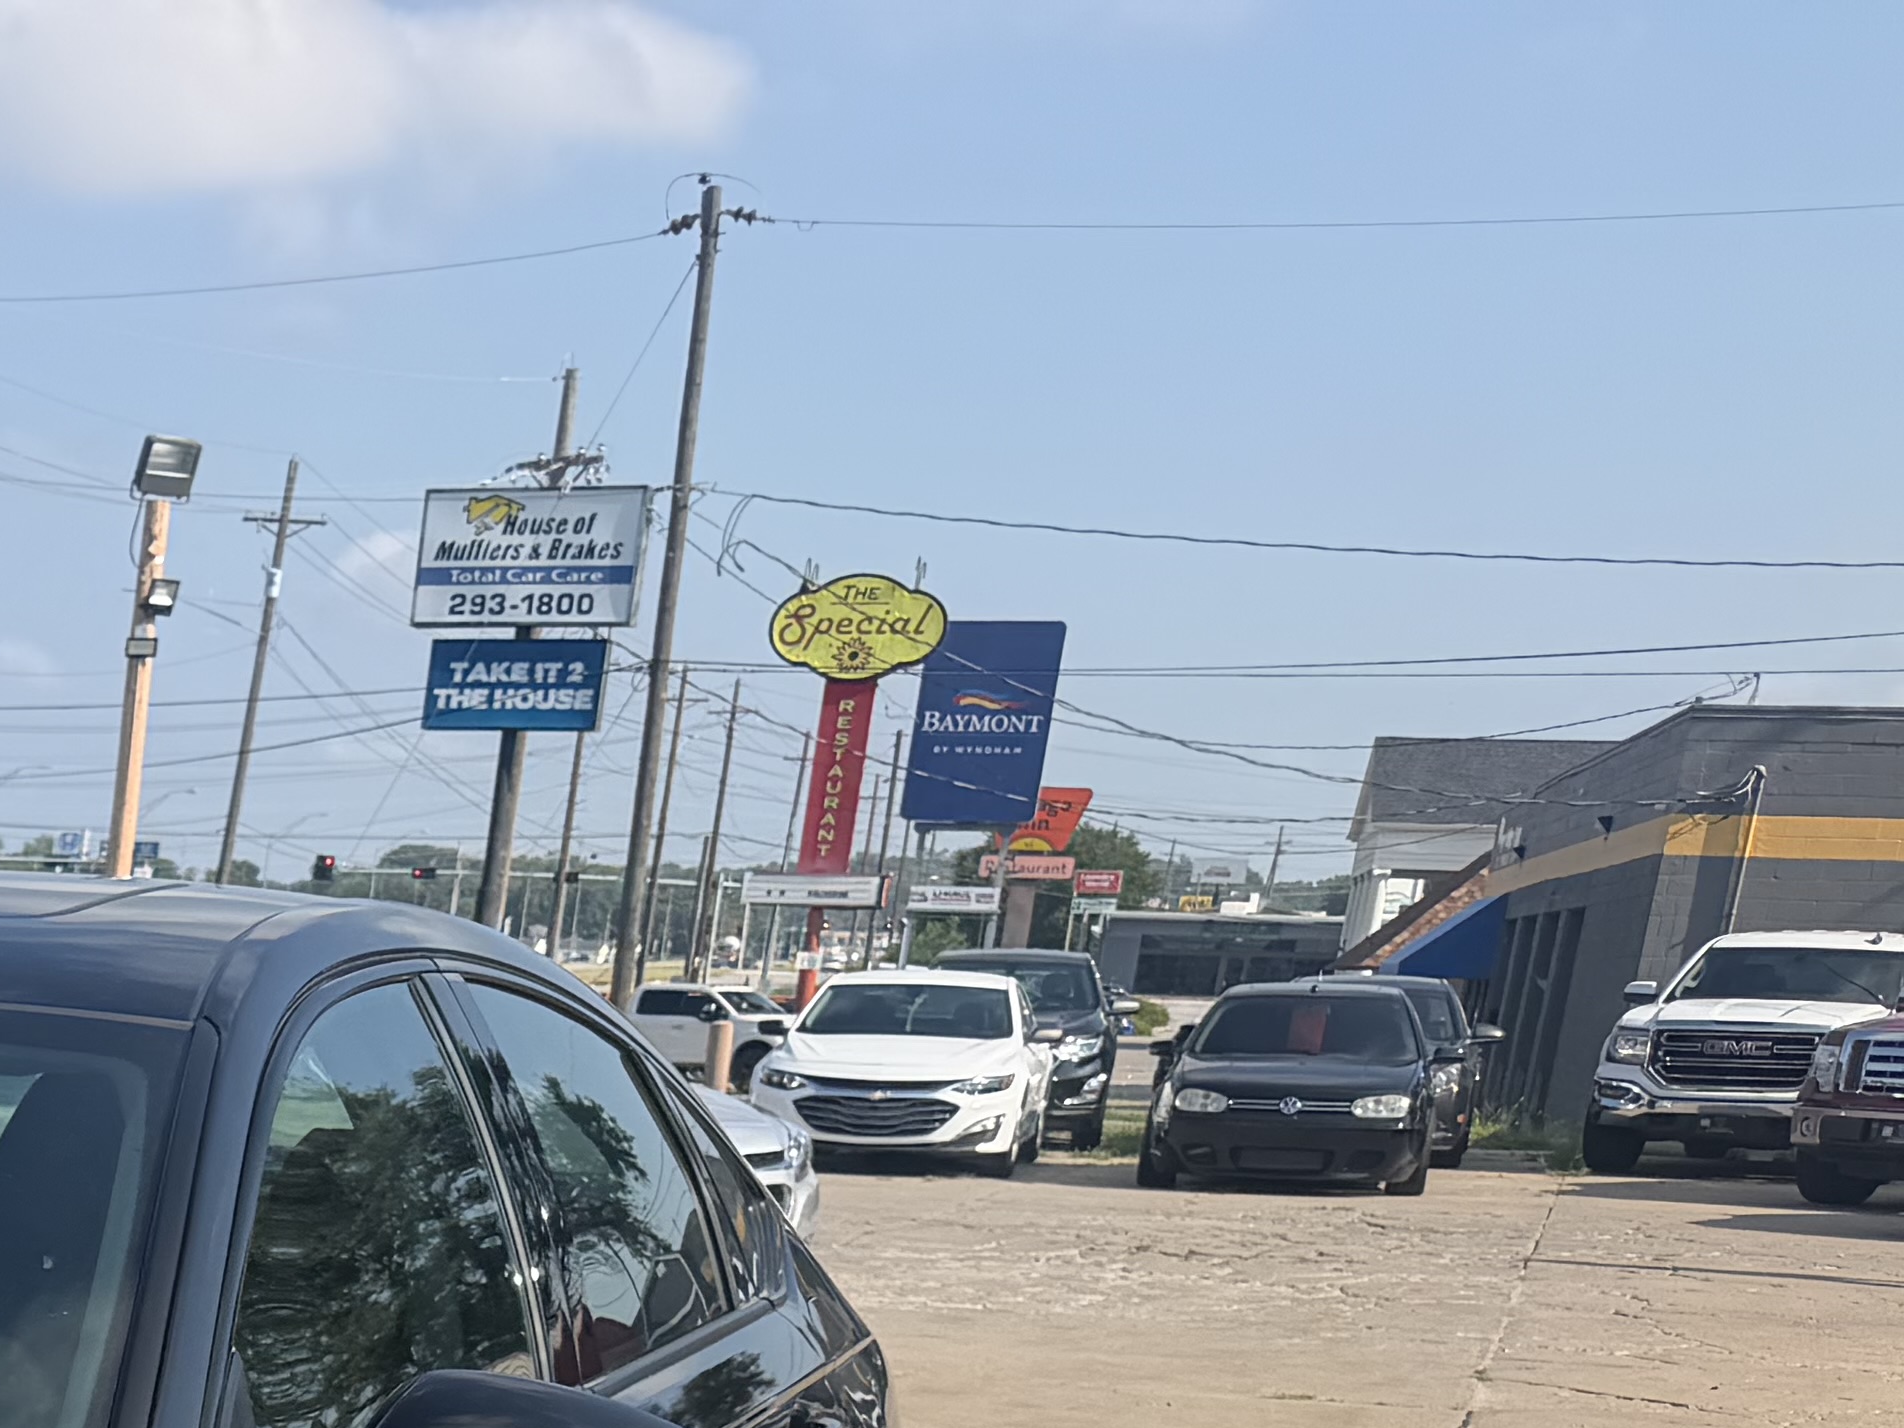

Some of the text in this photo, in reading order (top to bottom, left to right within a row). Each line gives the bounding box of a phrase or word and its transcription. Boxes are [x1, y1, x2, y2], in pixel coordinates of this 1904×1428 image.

[501, 512, 598, 536] House of
[434, 538, 624, 562] Mufflers & Brakes
[449, 568, 605, 584] Total Car Care
[448, 592, 594, 616] 293-1800
[843, 584, 882, 602] THE
[778, 602, 934, 651] Special
[449, 661, 587, 684] TAKE IT 2
[433, 688, 595, 711] THE HOUSE
[921, 711, 1045, 735] BAYMONT
[817, 700, 855, 857] RESTAURANT
[1703, 1039, 1773, 1056] GMC
